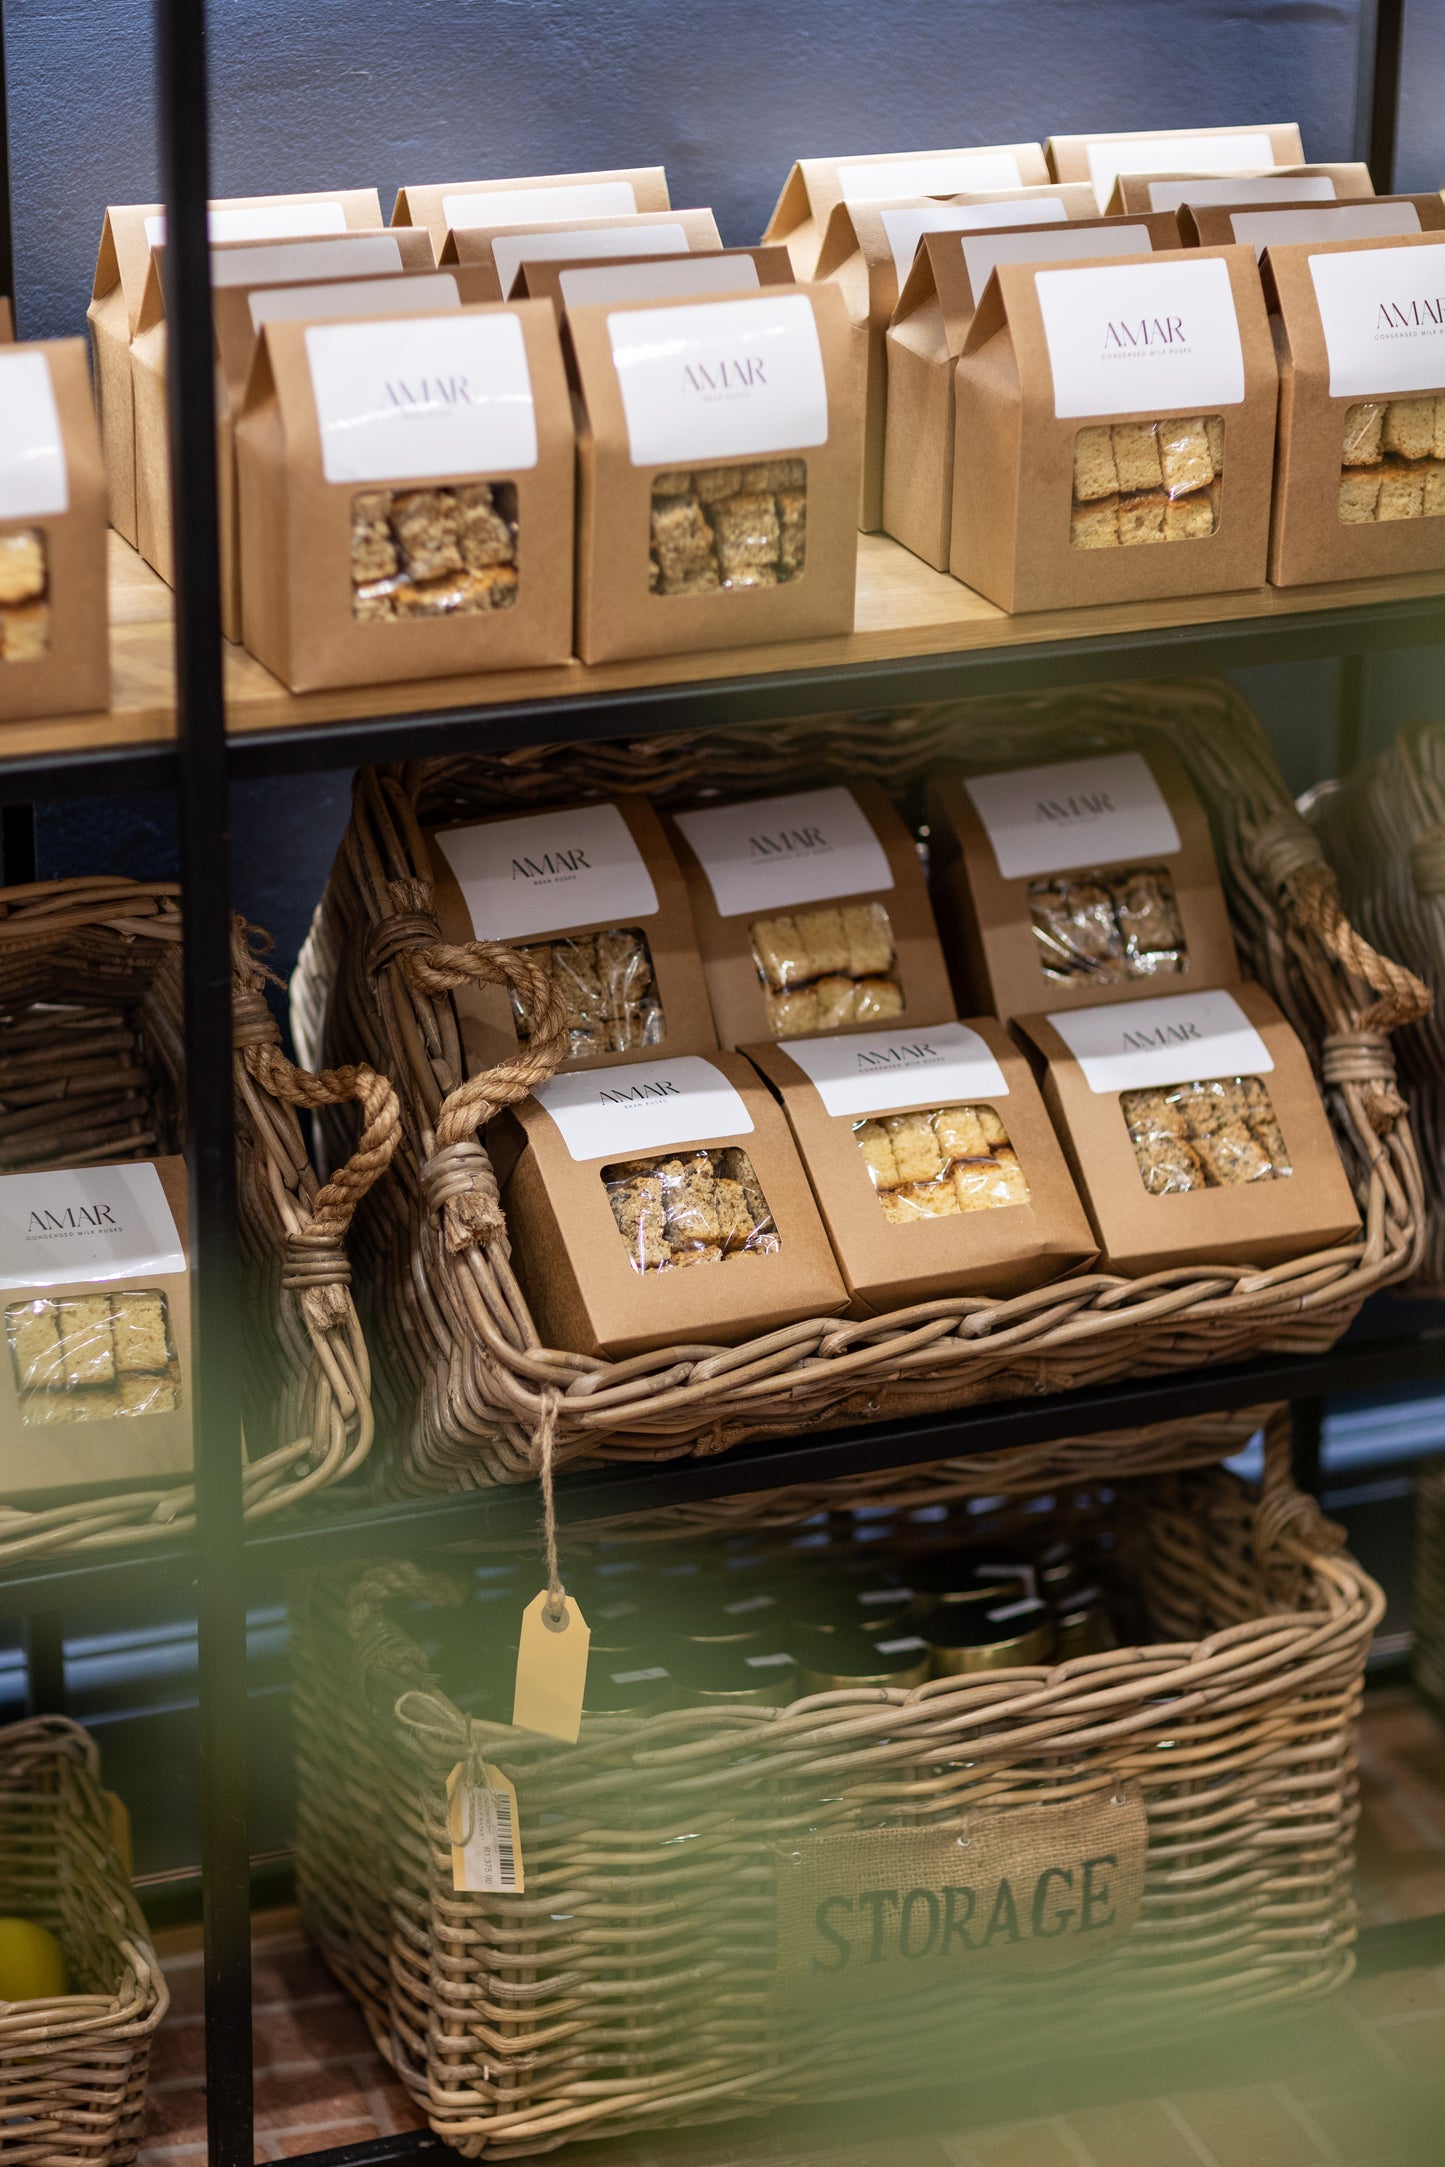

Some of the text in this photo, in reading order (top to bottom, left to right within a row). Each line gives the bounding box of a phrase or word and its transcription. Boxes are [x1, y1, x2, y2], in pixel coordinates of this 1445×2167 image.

[1104, 317, 1186, 348] AMAR
[682, 358, 767, 393] AMAR
[382, 375, 471, 406] AMAR
[750, 827, 827, 856] AMAR
[512, 849, 591, 880] AMAR
[1123, 1022, 1202, 1051] AMAR
[857, 1043, 937, 1067] AMAR
[599, 1081, 681, 1106] AMAR
[28, 1204, 116, 1232] AMAR
[25, 1231, 74, 1241] CONDENSED
[811, 1854, 1119, 1973] STORAGE
